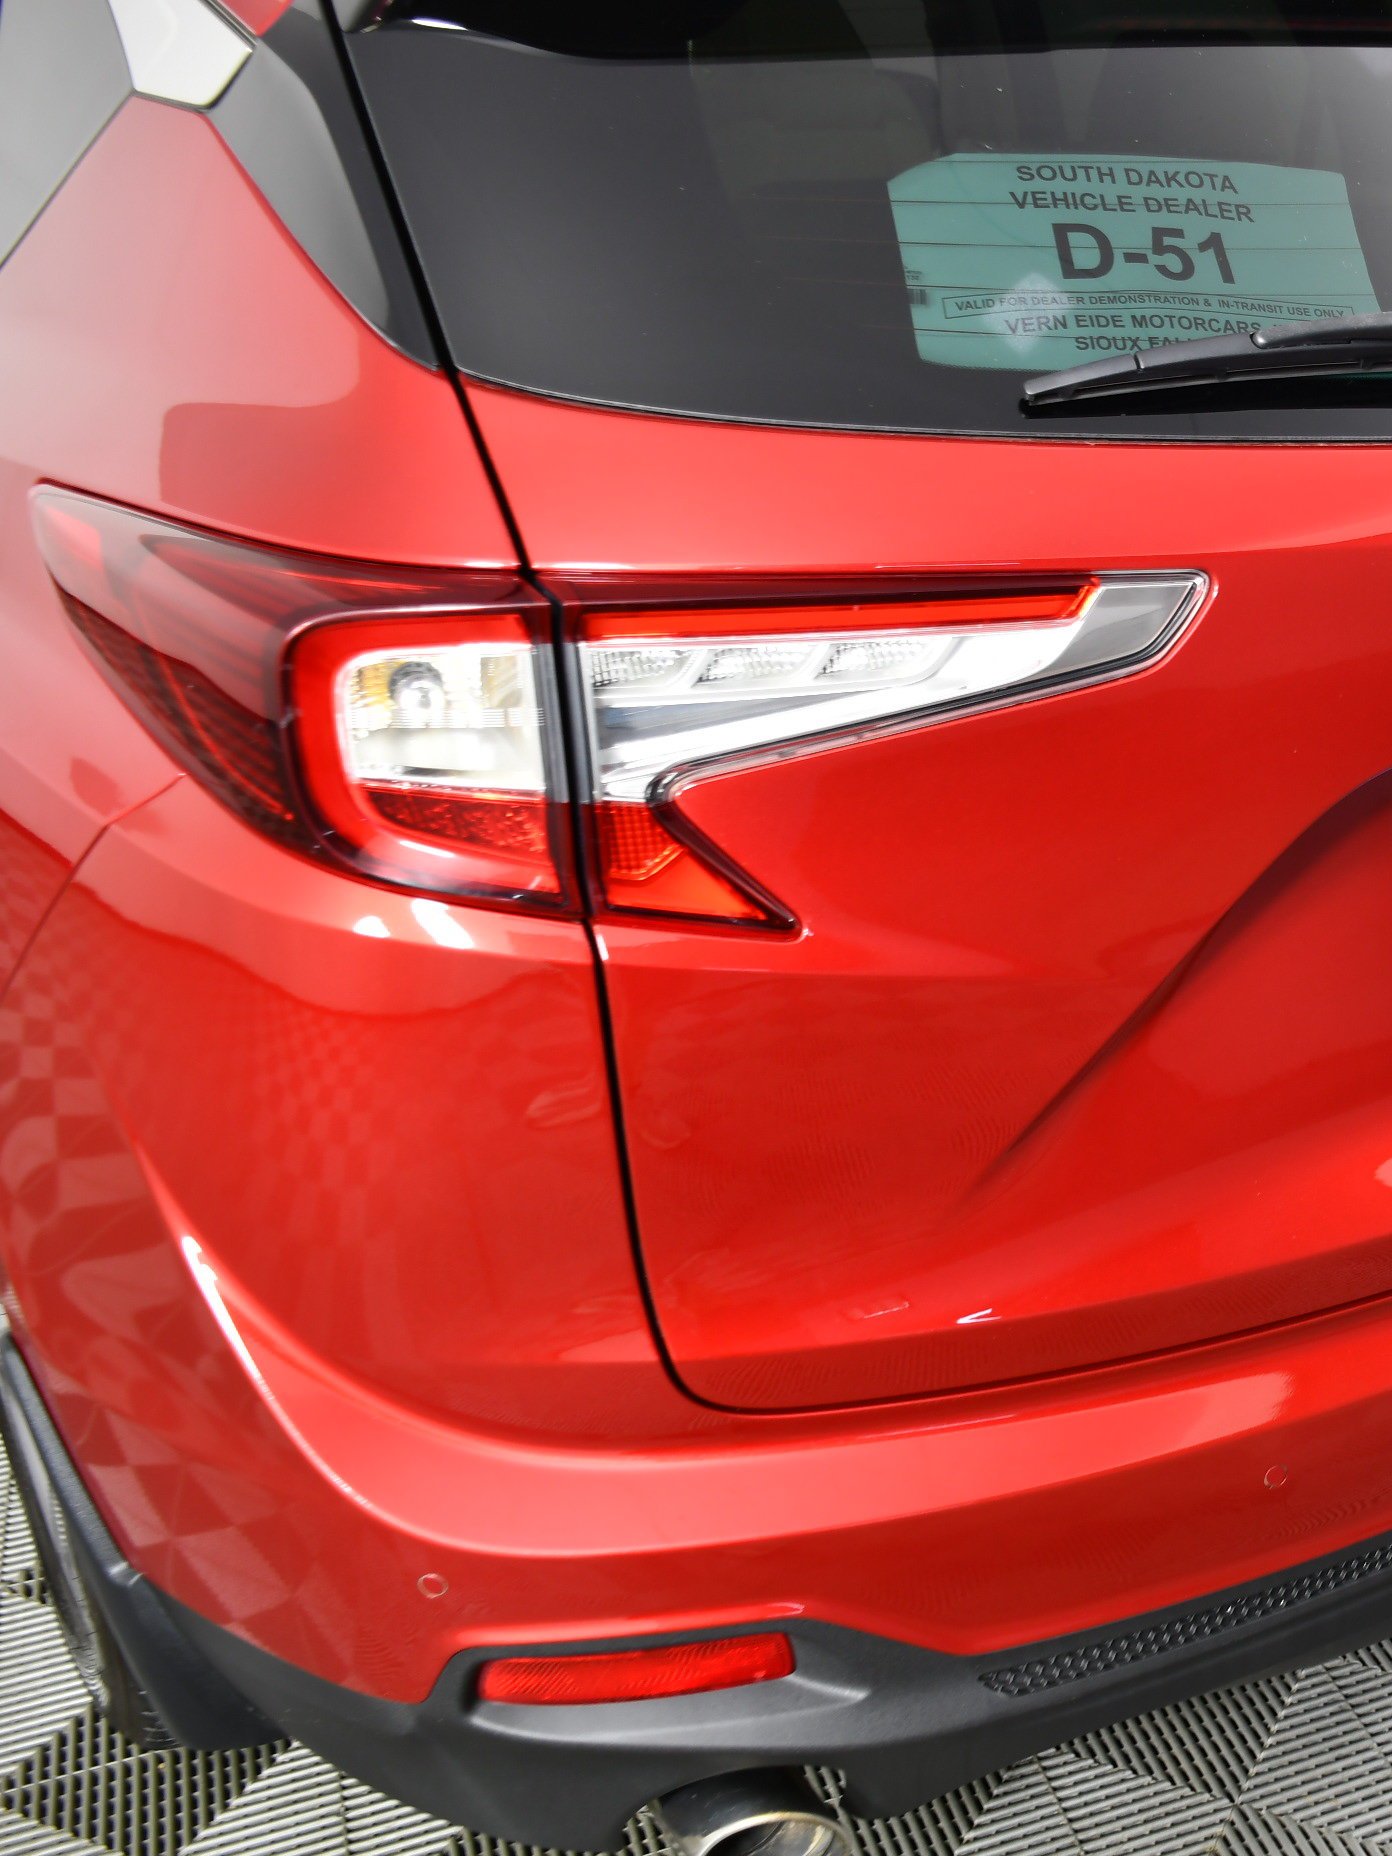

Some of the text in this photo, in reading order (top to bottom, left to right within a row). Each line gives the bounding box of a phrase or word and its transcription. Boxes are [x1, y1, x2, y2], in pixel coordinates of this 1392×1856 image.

[1016, 165, 1239, 195] SOUTH DAKOTA
[1009, 191, 1255, 223] VEHICLE DEALER
[1051, 222, 1236, 285] D-51
[955, 294, 1344, 320] VALID FOR DEALER DEMONSTRATION & IN-TRANSIT USE ONLY
[1005, 314, 1262, 336] VERN EIDE MOTORCARS
[1074, 335, 1143, 352] SIOUX
